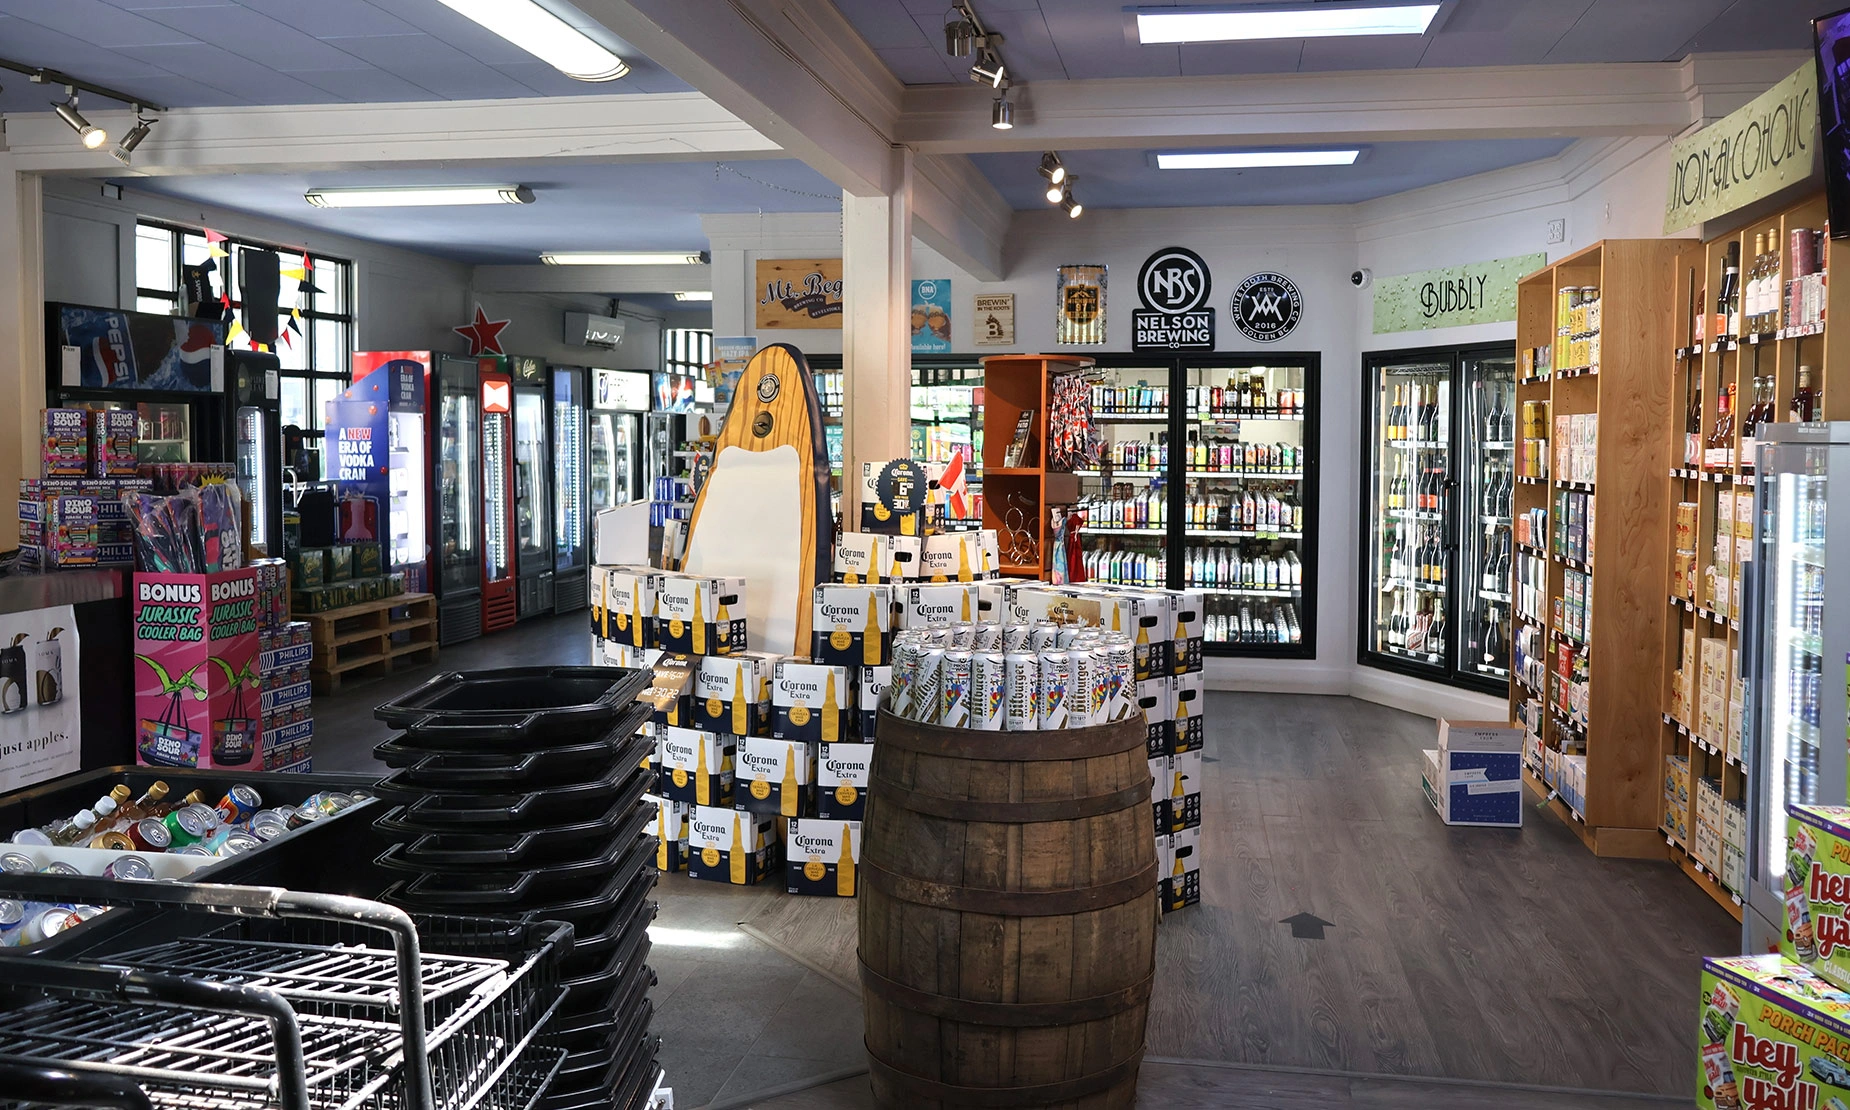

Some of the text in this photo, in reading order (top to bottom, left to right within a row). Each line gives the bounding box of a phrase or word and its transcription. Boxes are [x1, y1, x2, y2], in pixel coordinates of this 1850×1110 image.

[1671, 87, 1809, 211] NON-ALCOHOLIC
[921, 286, 934, 294] BNA
[1153, 267, 1195, 304] NBC
[761, 280, 800, 305] Mt.
[1233, 275, 1300, 321] WHITETOOTH BREWING
[1420, 274, 1487, 318] BUBBLY
[793, 299, 815, 310] BREWING
[977, 299, 1010, 307] BREWIN'
[1137, 316, 1208, 330] NELSON
[1137, 329, 1210, 343] BREWING
[1242, 326, 1289, 340] GOLDEN BC
[105, 316, 129, 382] PEPSI
[54, 412, 81, 420] DINO
[54, 419, 81, 427] SOUR
[338, 427, 372, 440] A NEW
[338, 441, 372, 454] ERA OF
[338, 454, 374, 467] VODKA
[338, 468, 366, 480] CRAN
[891, 468, 914, 477] Corona
[64, 499, 92, 507] DINO
[64, 506, 93, 514] SOUR
[838, 547, 866, 559] Corona
[921, 550, 953, 561] Corona
[844, 558, 860, 566] Extra
[140, 583, 201, 603] BONUS
[211, 577, 255, 602] BONUS
[612, 586, 631, 600] Corona
[662, 593, 690, 606] Corona
[137, 605, 201, 624] JURASSIC
[209, 599, 255, 624] JURASSIC
[669, 603, 684, 613] Extra
[820, 603, 860, 617] Corona
[916, 603, 954, 616] Corona
[830, 614, 852, 623] Extra
[926, 613, 948, 622] Extra
[138, 625, 203, 641] COOLER BAG
[210, 618, 256, 640] COOLER BAG
[279, 647, 309, 660] PHILLIPS
[662, 658, 688, 668] Corona
[700, 671, 729, 686] Corona
[278, 685, 308, 699] PHILLIPS
[706, 683, 723, 692] Extra
[780, 679, 818, 693] Corona
[973, 662, 985, 717] Bitburger
[1008, 663, 1026, 718] Bitburger
[1070, 660, 1089, 713] Bitburger
[790, 691, 811, 699] Extra
[226, 733, 243, 741] DINO
[280, 723, 310, 738] PHILLIPS
[0, 731, 69, 760] just apples.
[156, 743, 181, 756] SOUR
[158, 737, 181, 749] DINO
[225, 740, 243, 748] SOUR
[666, 741, 693, 755] Corona
[672, 752, 688, 762] Extra
[742, 752, 778, 766] Corona
[751, 764, 771, 773] Extra
[826, 760, 865, 773] Corona
[836, 771, 858, 779] Extra
[693, 821, 727, 834] Corona
[702, 831, 720, 841] Extra
[795, 835, 834, 848] Corona
[805, 846, 826, 854] Extra
[1759, 1004, 1816, 1045] PORCH
[1732, 1021, 1802, 1091] hey
